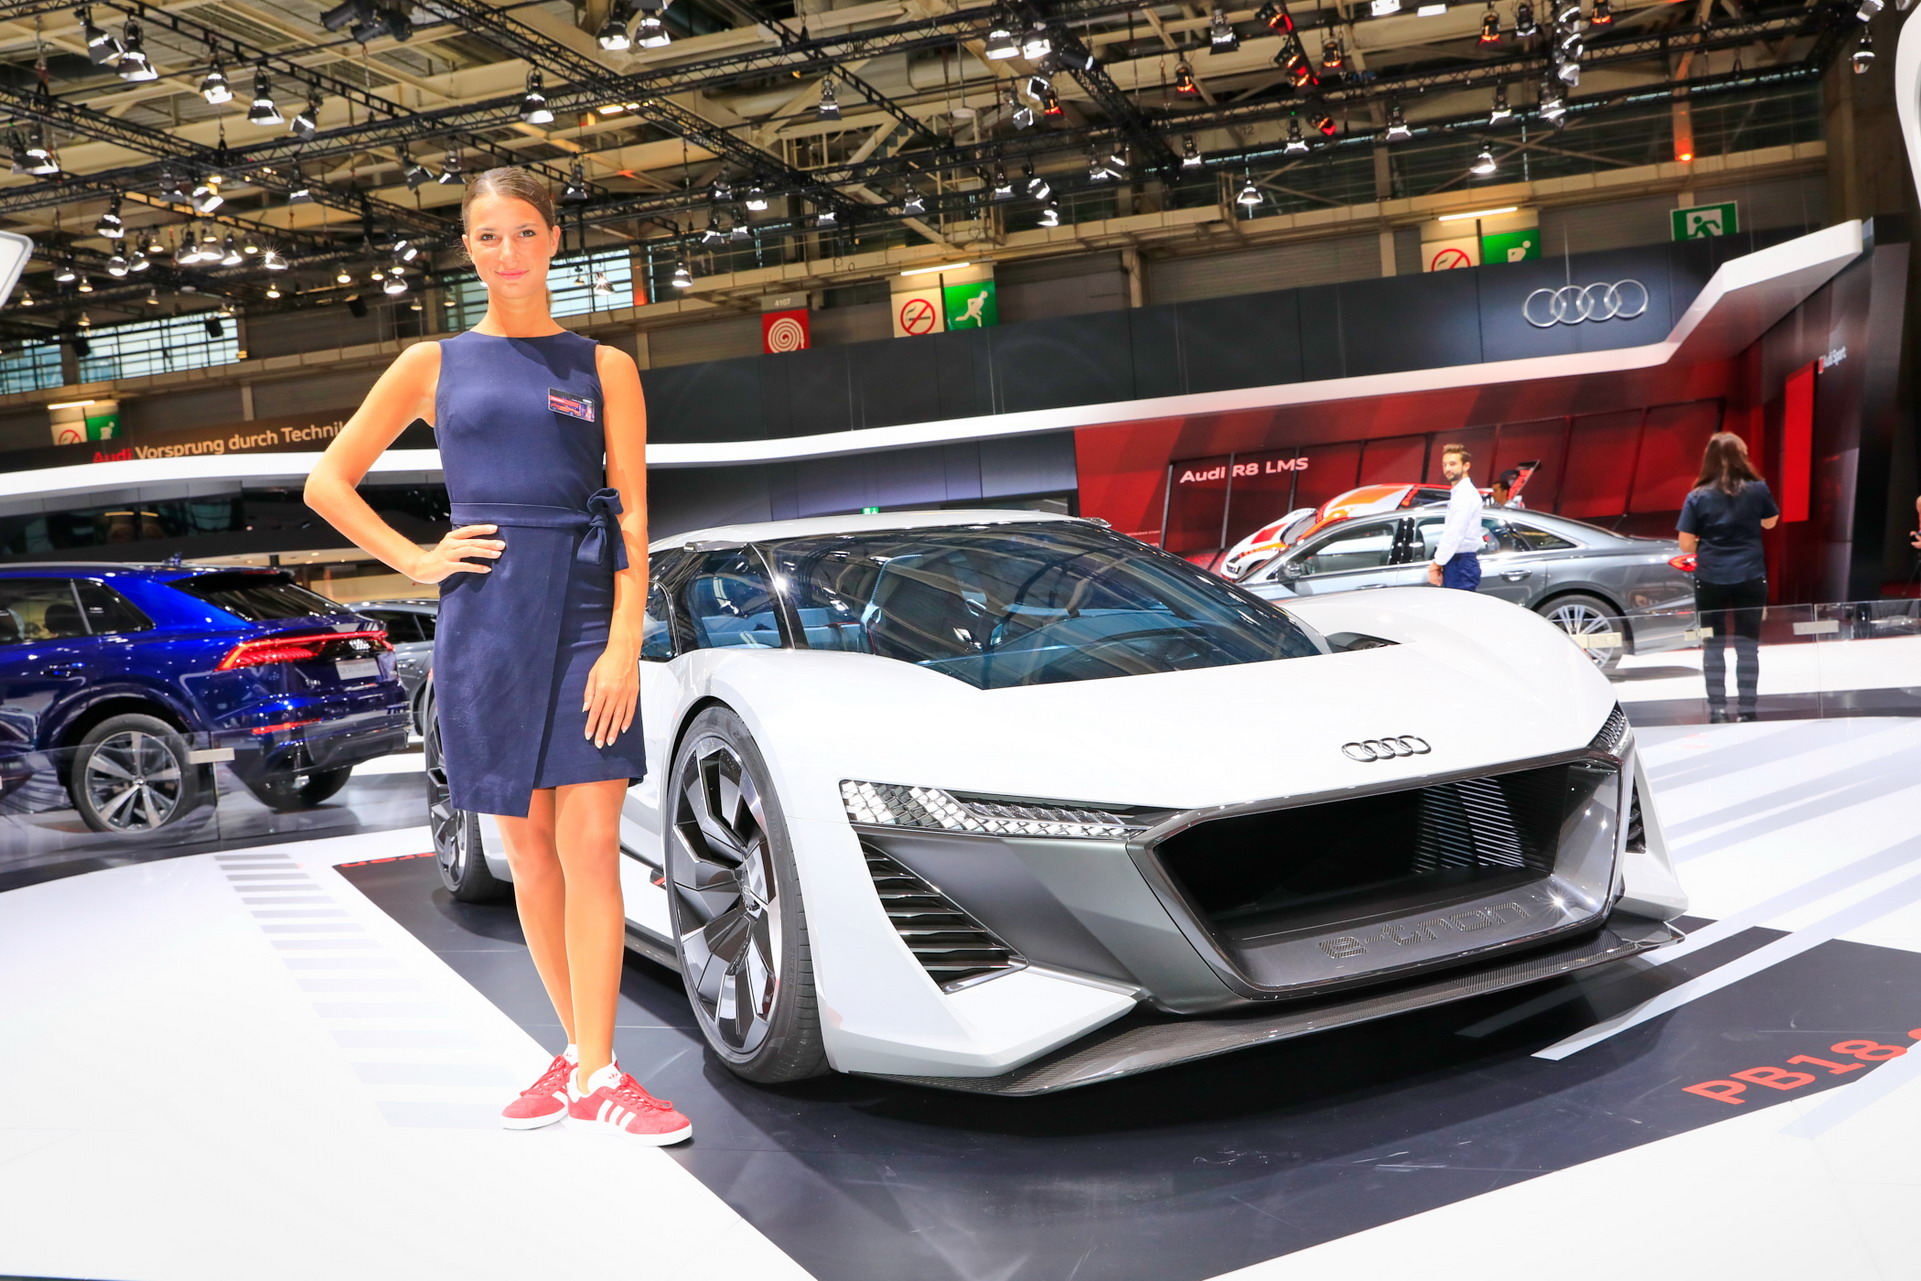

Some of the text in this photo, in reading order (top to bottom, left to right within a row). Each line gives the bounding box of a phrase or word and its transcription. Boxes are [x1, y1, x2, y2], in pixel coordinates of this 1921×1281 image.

[93, 448, 132, 464] Audi
[135, 438, 226, 460] Vorsprung
[228, 429, 279, 450] durch
[1179, 457, 1309, 483] Audi R8 LMS
[1319, 901, 1531, 959] e-tron
[1682, 1039, 1908, 1105] PB18
